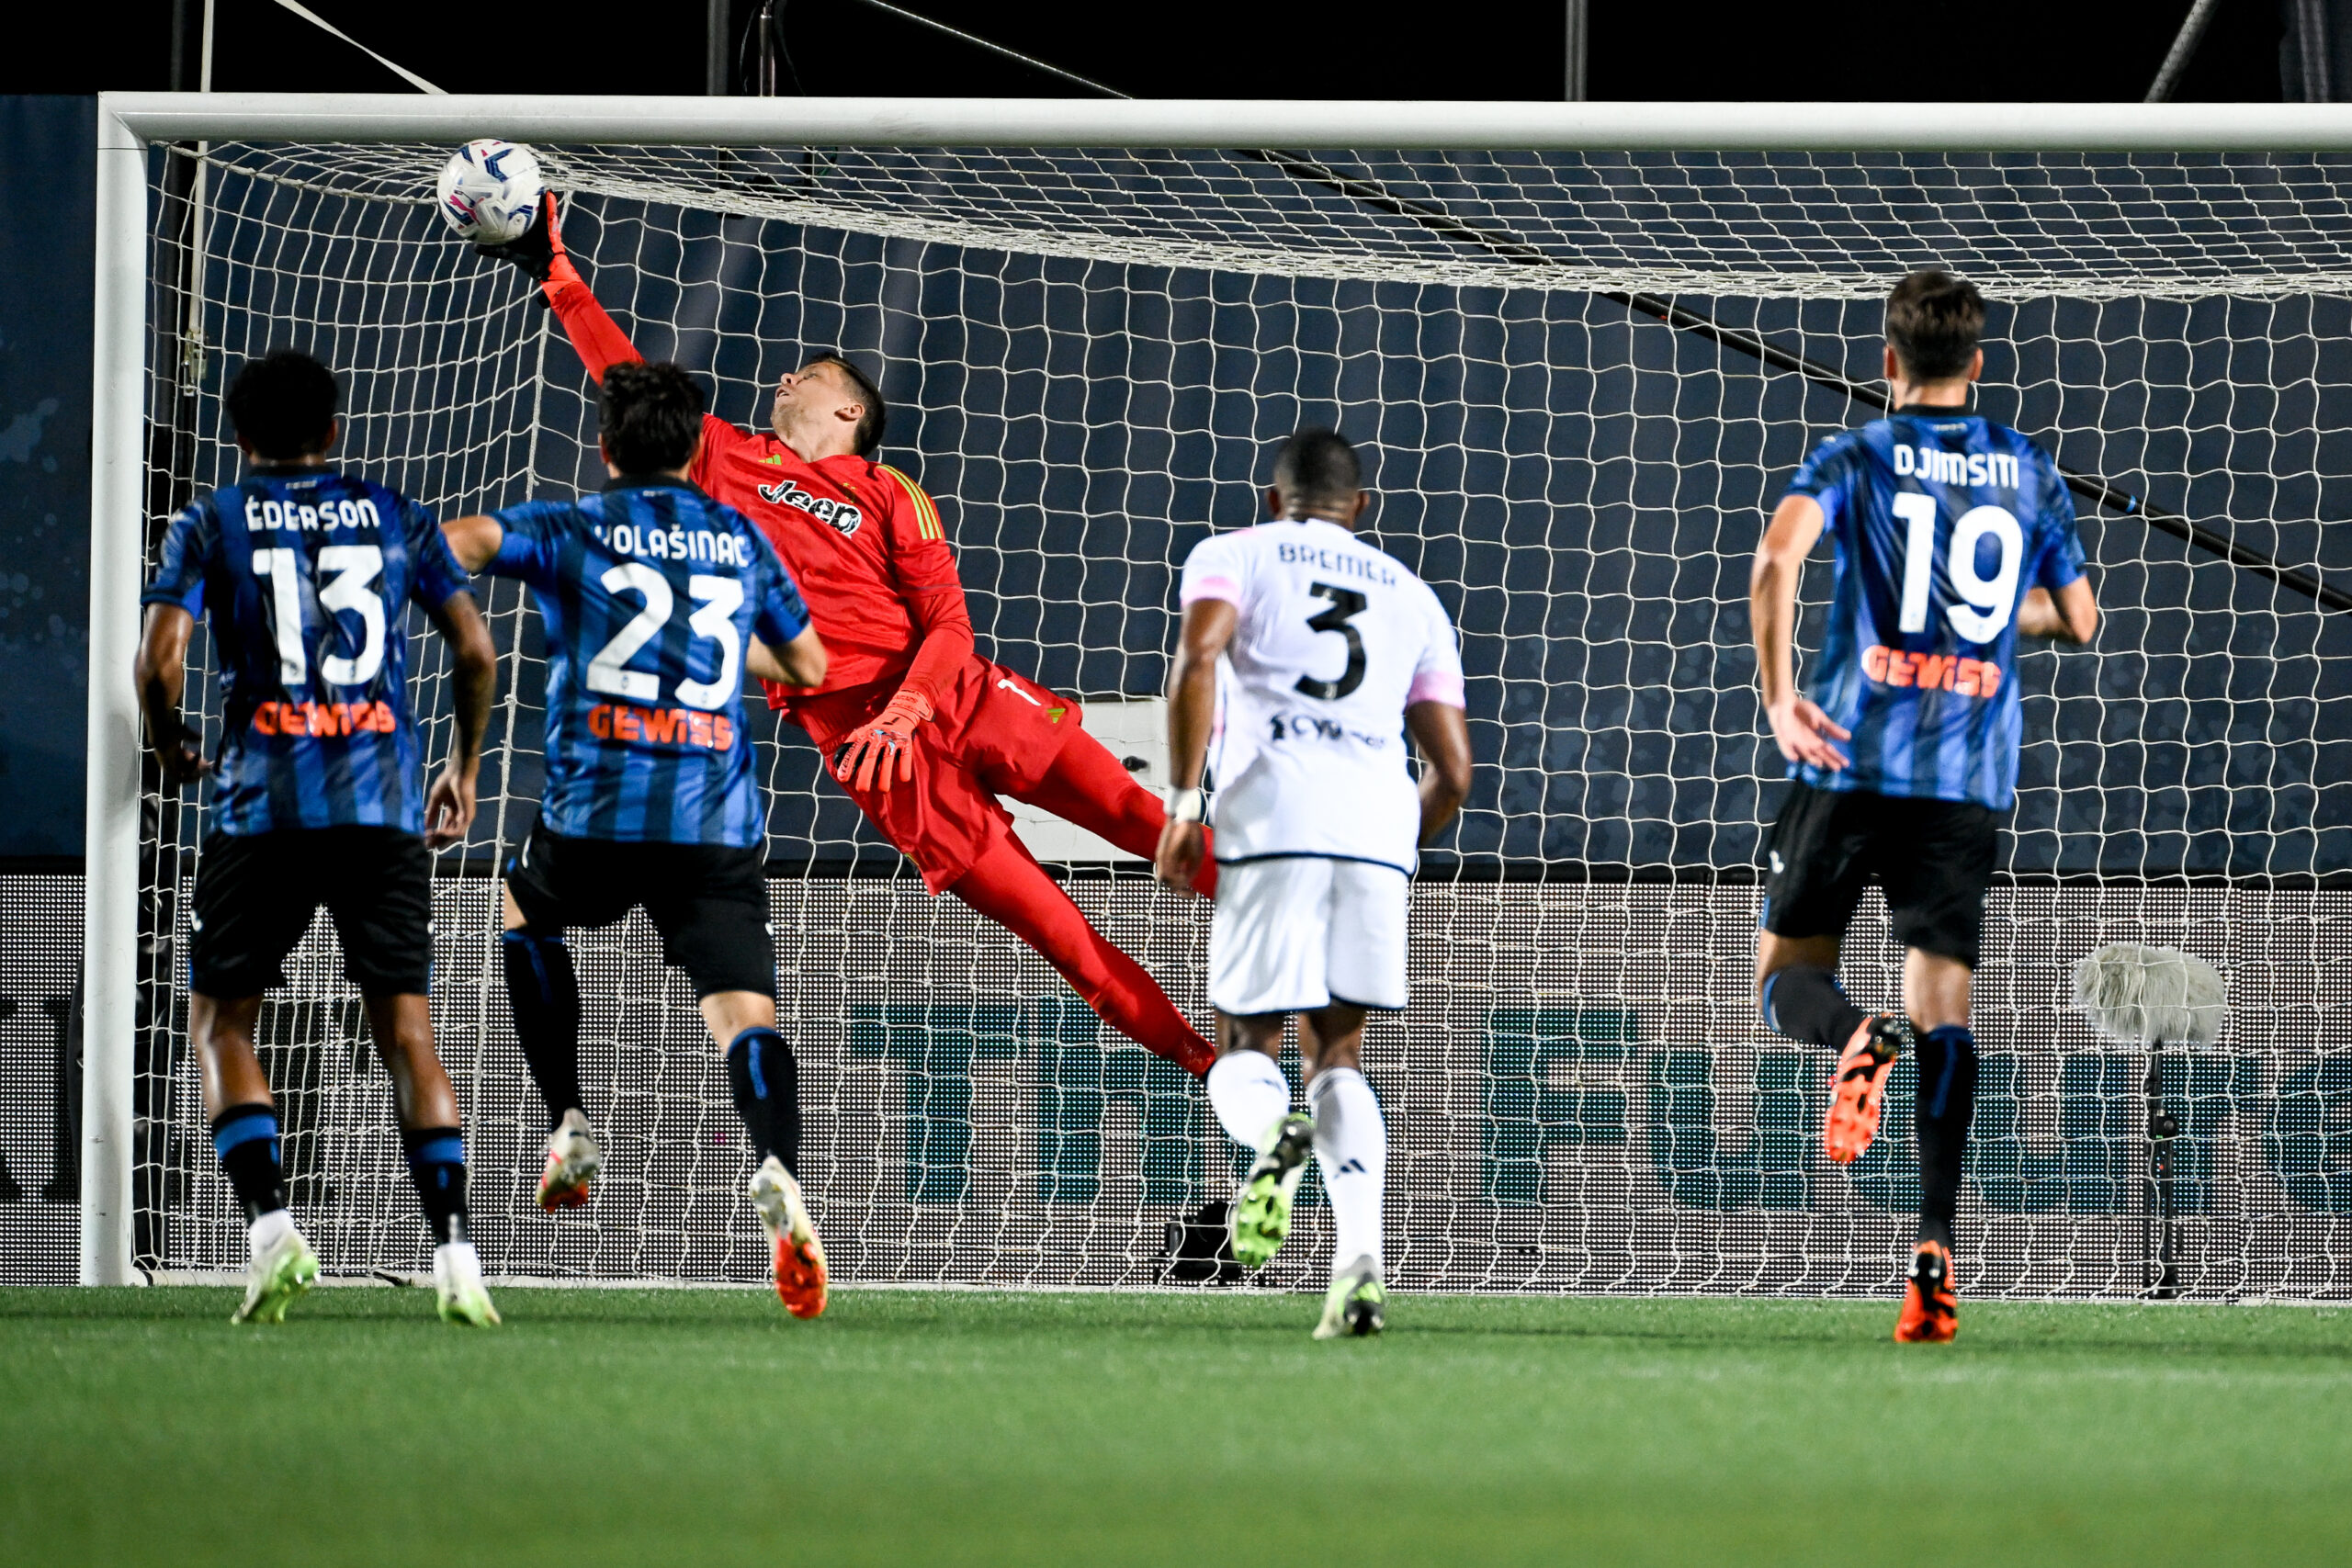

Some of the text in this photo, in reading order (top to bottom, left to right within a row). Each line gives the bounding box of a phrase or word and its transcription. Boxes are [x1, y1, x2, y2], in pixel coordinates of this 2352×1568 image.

[244, 495, 379, 532] ÉDERSON
[758, 480, 862, 538] Jeep
[1894, 445, 2019, 489] DJIMSITI
[253, 545, 384, 685] 13
[1892, 491, 2022, 643] 19
[586, 562, 744, 710] 23
[997, 678, 1042, 706] 1
[1294, 581, 1367, 700] 3
[851, 997, 1332, 1205] Th
